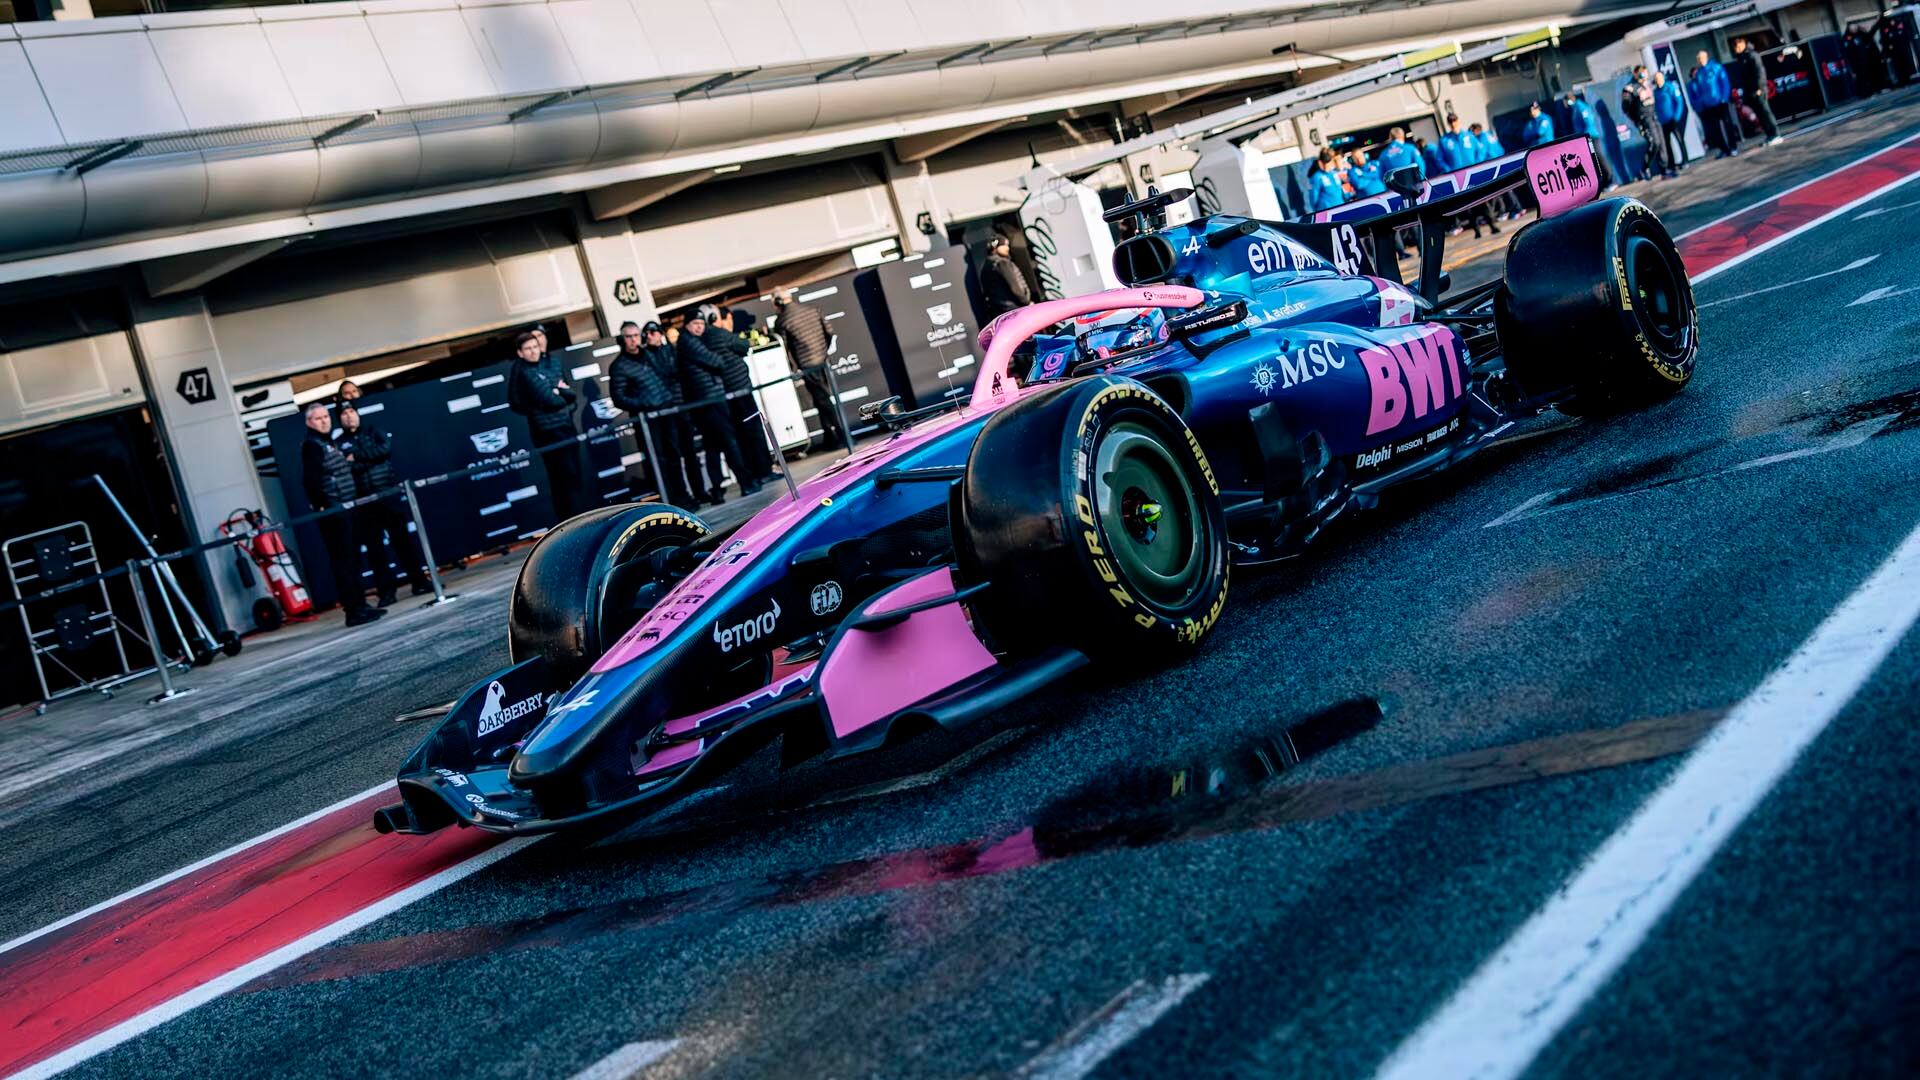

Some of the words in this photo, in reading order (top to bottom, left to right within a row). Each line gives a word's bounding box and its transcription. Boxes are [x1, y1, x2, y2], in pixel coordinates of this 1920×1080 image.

[1537, 159, 1565, 196] eni
[1247, 238, 1287, 273] eni
[1331, 224, 1363, 275] 43
[618, 281, 637, 302] 46
[1276, 338, 1345, 389] MSC
[1358, 321, 1463, 437] BWT
[184, 373, 208, 398] 47
[1356, 444, 1392, 469] Delphi
[1396, 437, 1423, 454] MISSION
[1075, 494, 1135, 608] ZERO
[479, 692, 543, 734] OAKBERRY
